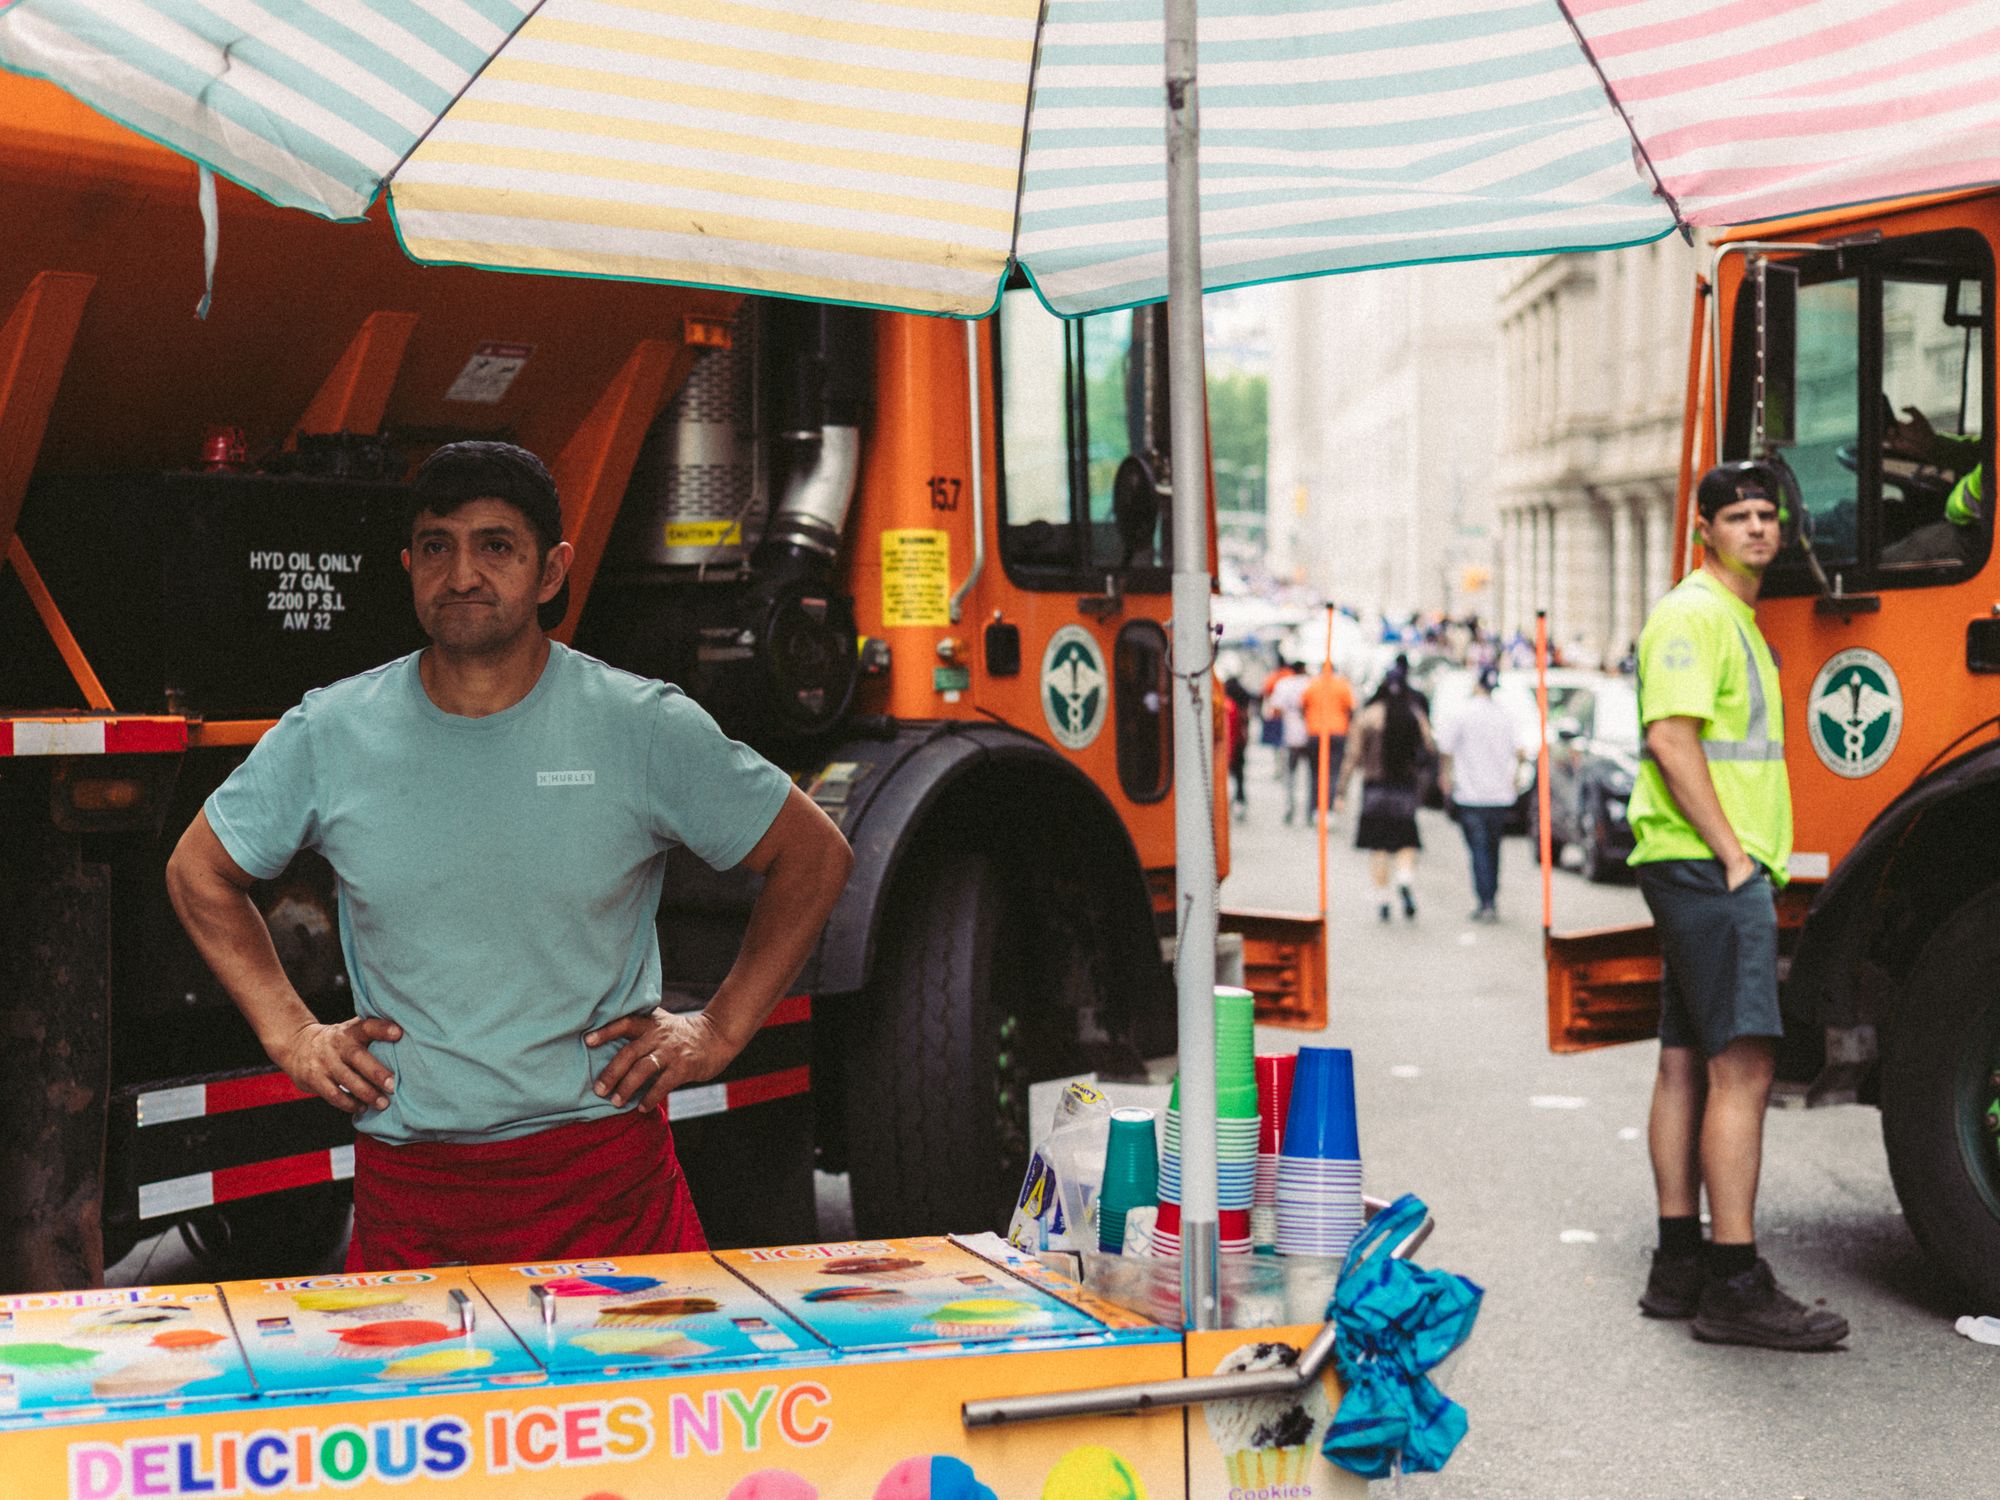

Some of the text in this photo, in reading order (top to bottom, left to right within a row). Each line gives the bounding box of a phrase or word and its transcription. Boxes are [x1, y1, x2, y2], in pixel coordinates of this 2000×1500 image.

[928, 477, 960, 510] 157
[250, 552, 361, 572] HYD OIL ONLY
[279, 572, 335, 591] 27 GAL
[267, 592, 303, 610] 2200
[283, 612, 331, 630] AW 32
[551, 773, 593, 783] HURLEY
[510, 1260, 621, 1278] US
[741, 1240, 896, 1263] ICES
[70, 1382, 830, 1500] DELICIOUS ICES NYC
[1228, 1484, 1312, 1500] Cookies
